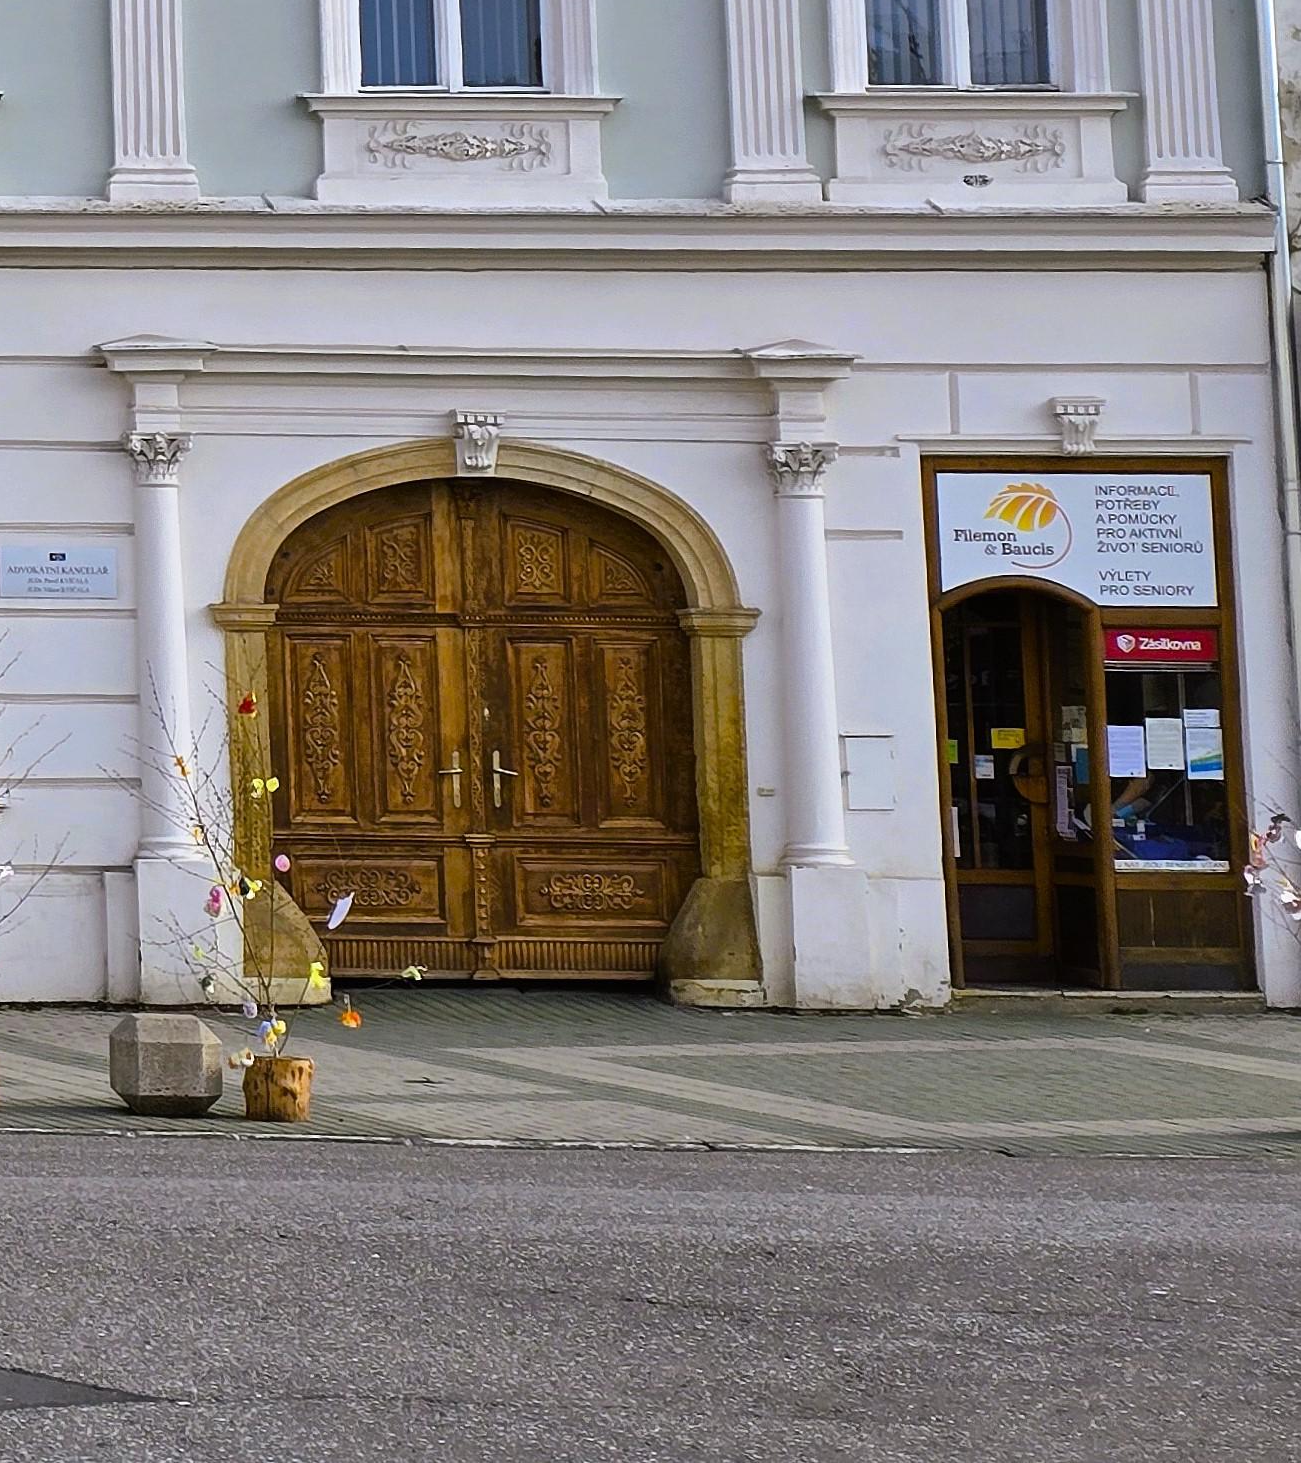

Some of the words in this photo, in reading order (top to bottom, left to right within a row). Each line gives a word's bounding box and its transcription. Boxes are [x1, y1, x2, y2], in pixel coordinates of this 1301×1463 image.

[1095, 498, 1161, 511] POTŘEBY
[1096, 514, 1105, 525] A
[1107, 512, 1177, 525] POMŮCKY
[953, 529, 1018, 542] Filemon
[1096, 528, 1126, 539] PRO
[1129, 526, 1183, 539] AKTIVNÍ
[984, 544, 998, 556] &
[1001, 543, 1055, 556] Baucis
[1097, 541, 1136, 554] ŽIVOT
[1141, 540, 1204, 554] SENIORŮ
[1099, 568, 1152, 582] VÝLETY
[1100, 585, 1130, 596] PRO
[1133, 585, 1195, 596] SENIORY
[1138, 637, 1203, 651] Zásilkovna
